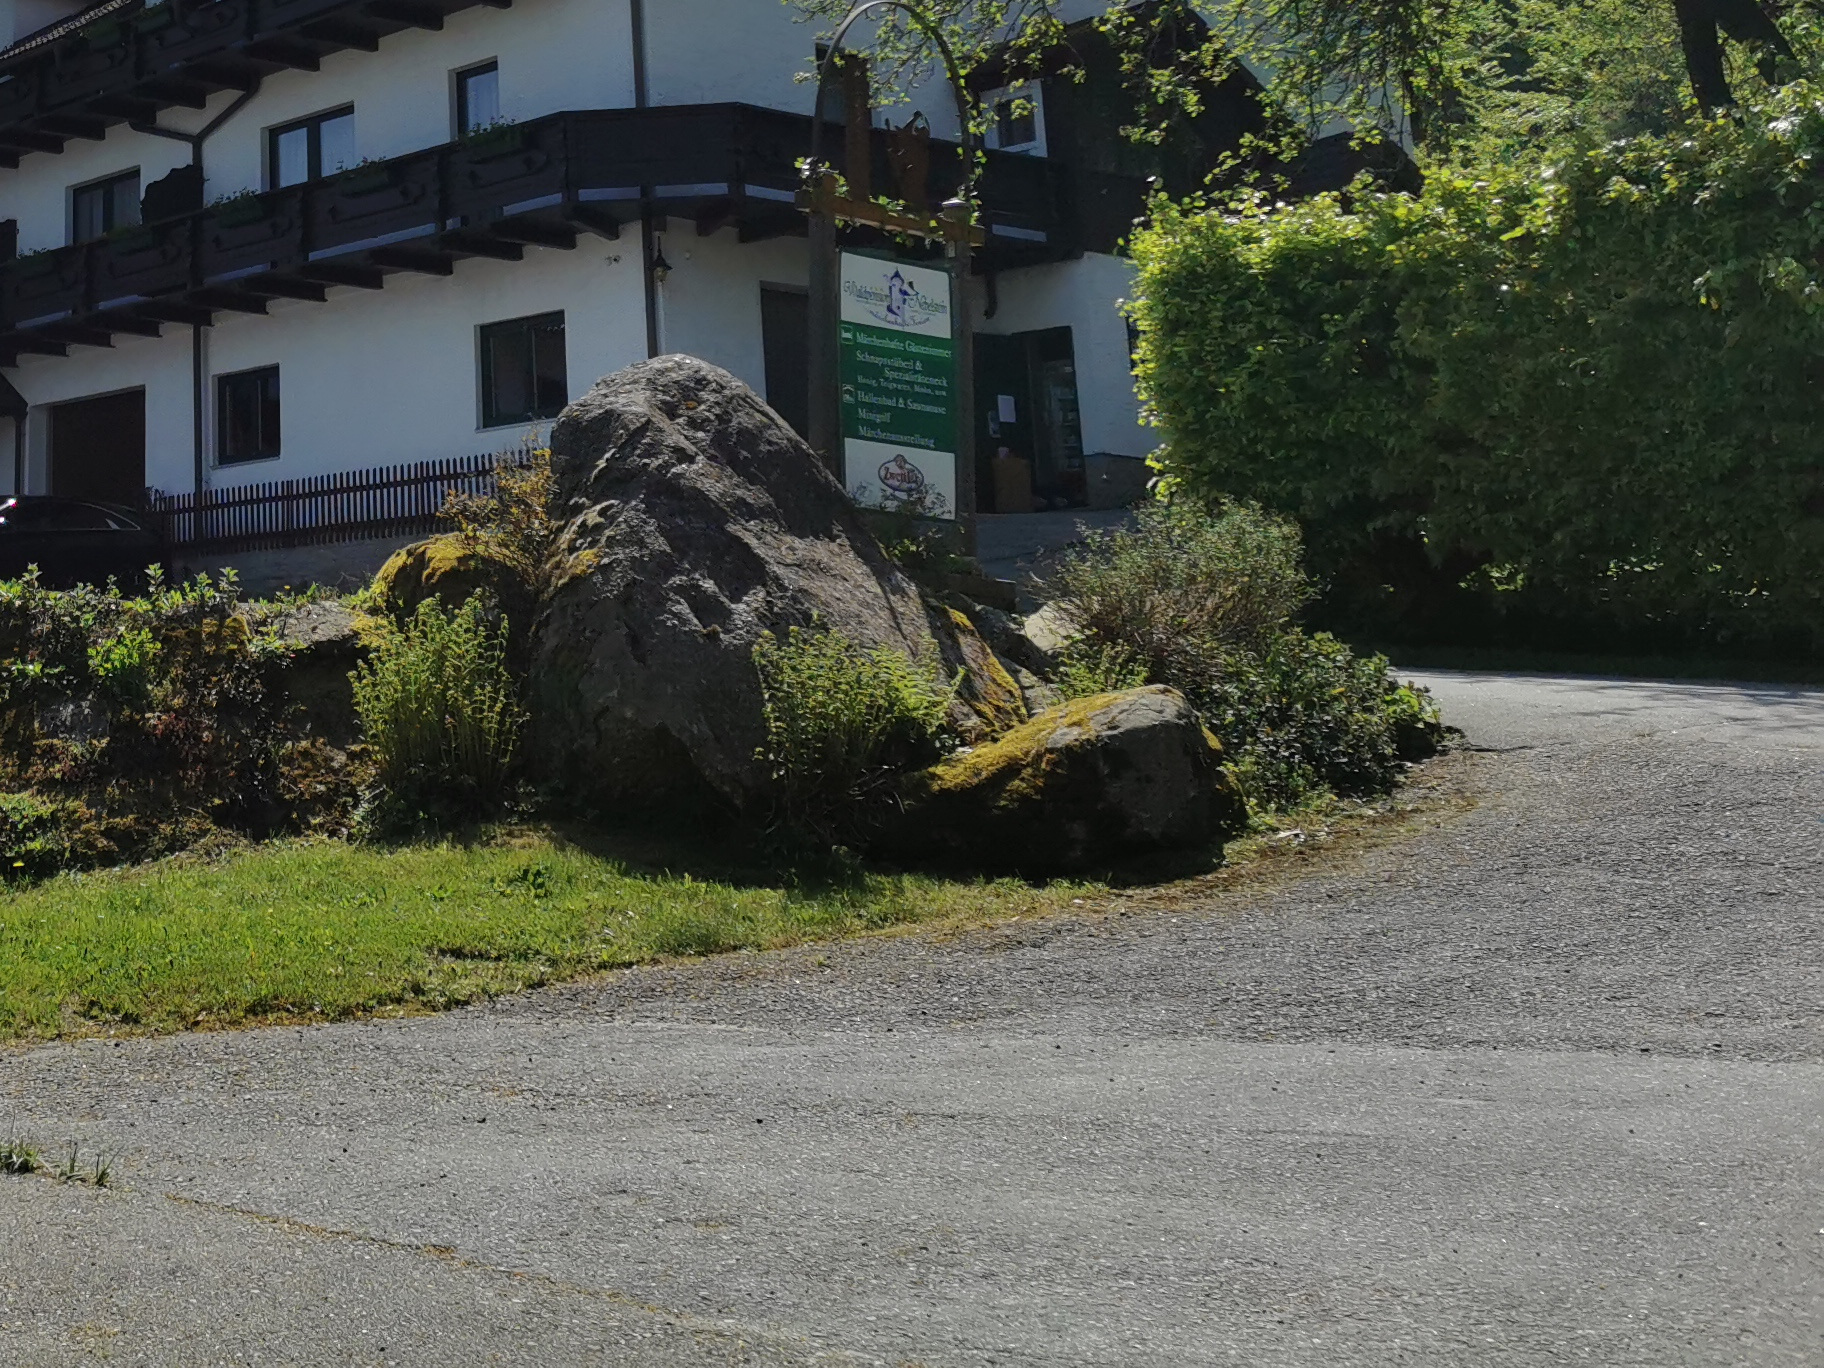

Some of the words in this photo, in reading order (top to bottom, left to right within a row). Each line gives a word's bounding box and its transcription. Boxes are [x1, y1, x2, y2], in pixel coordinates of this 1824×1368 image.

[856, 331, 905, 350] Märchenhafte
[915, 360, 923, 370] &
[857, 390, 896, 407] Hallenbad
[898, 397, 906, 408] &
[857, 407, 891, 423] Minigolf
